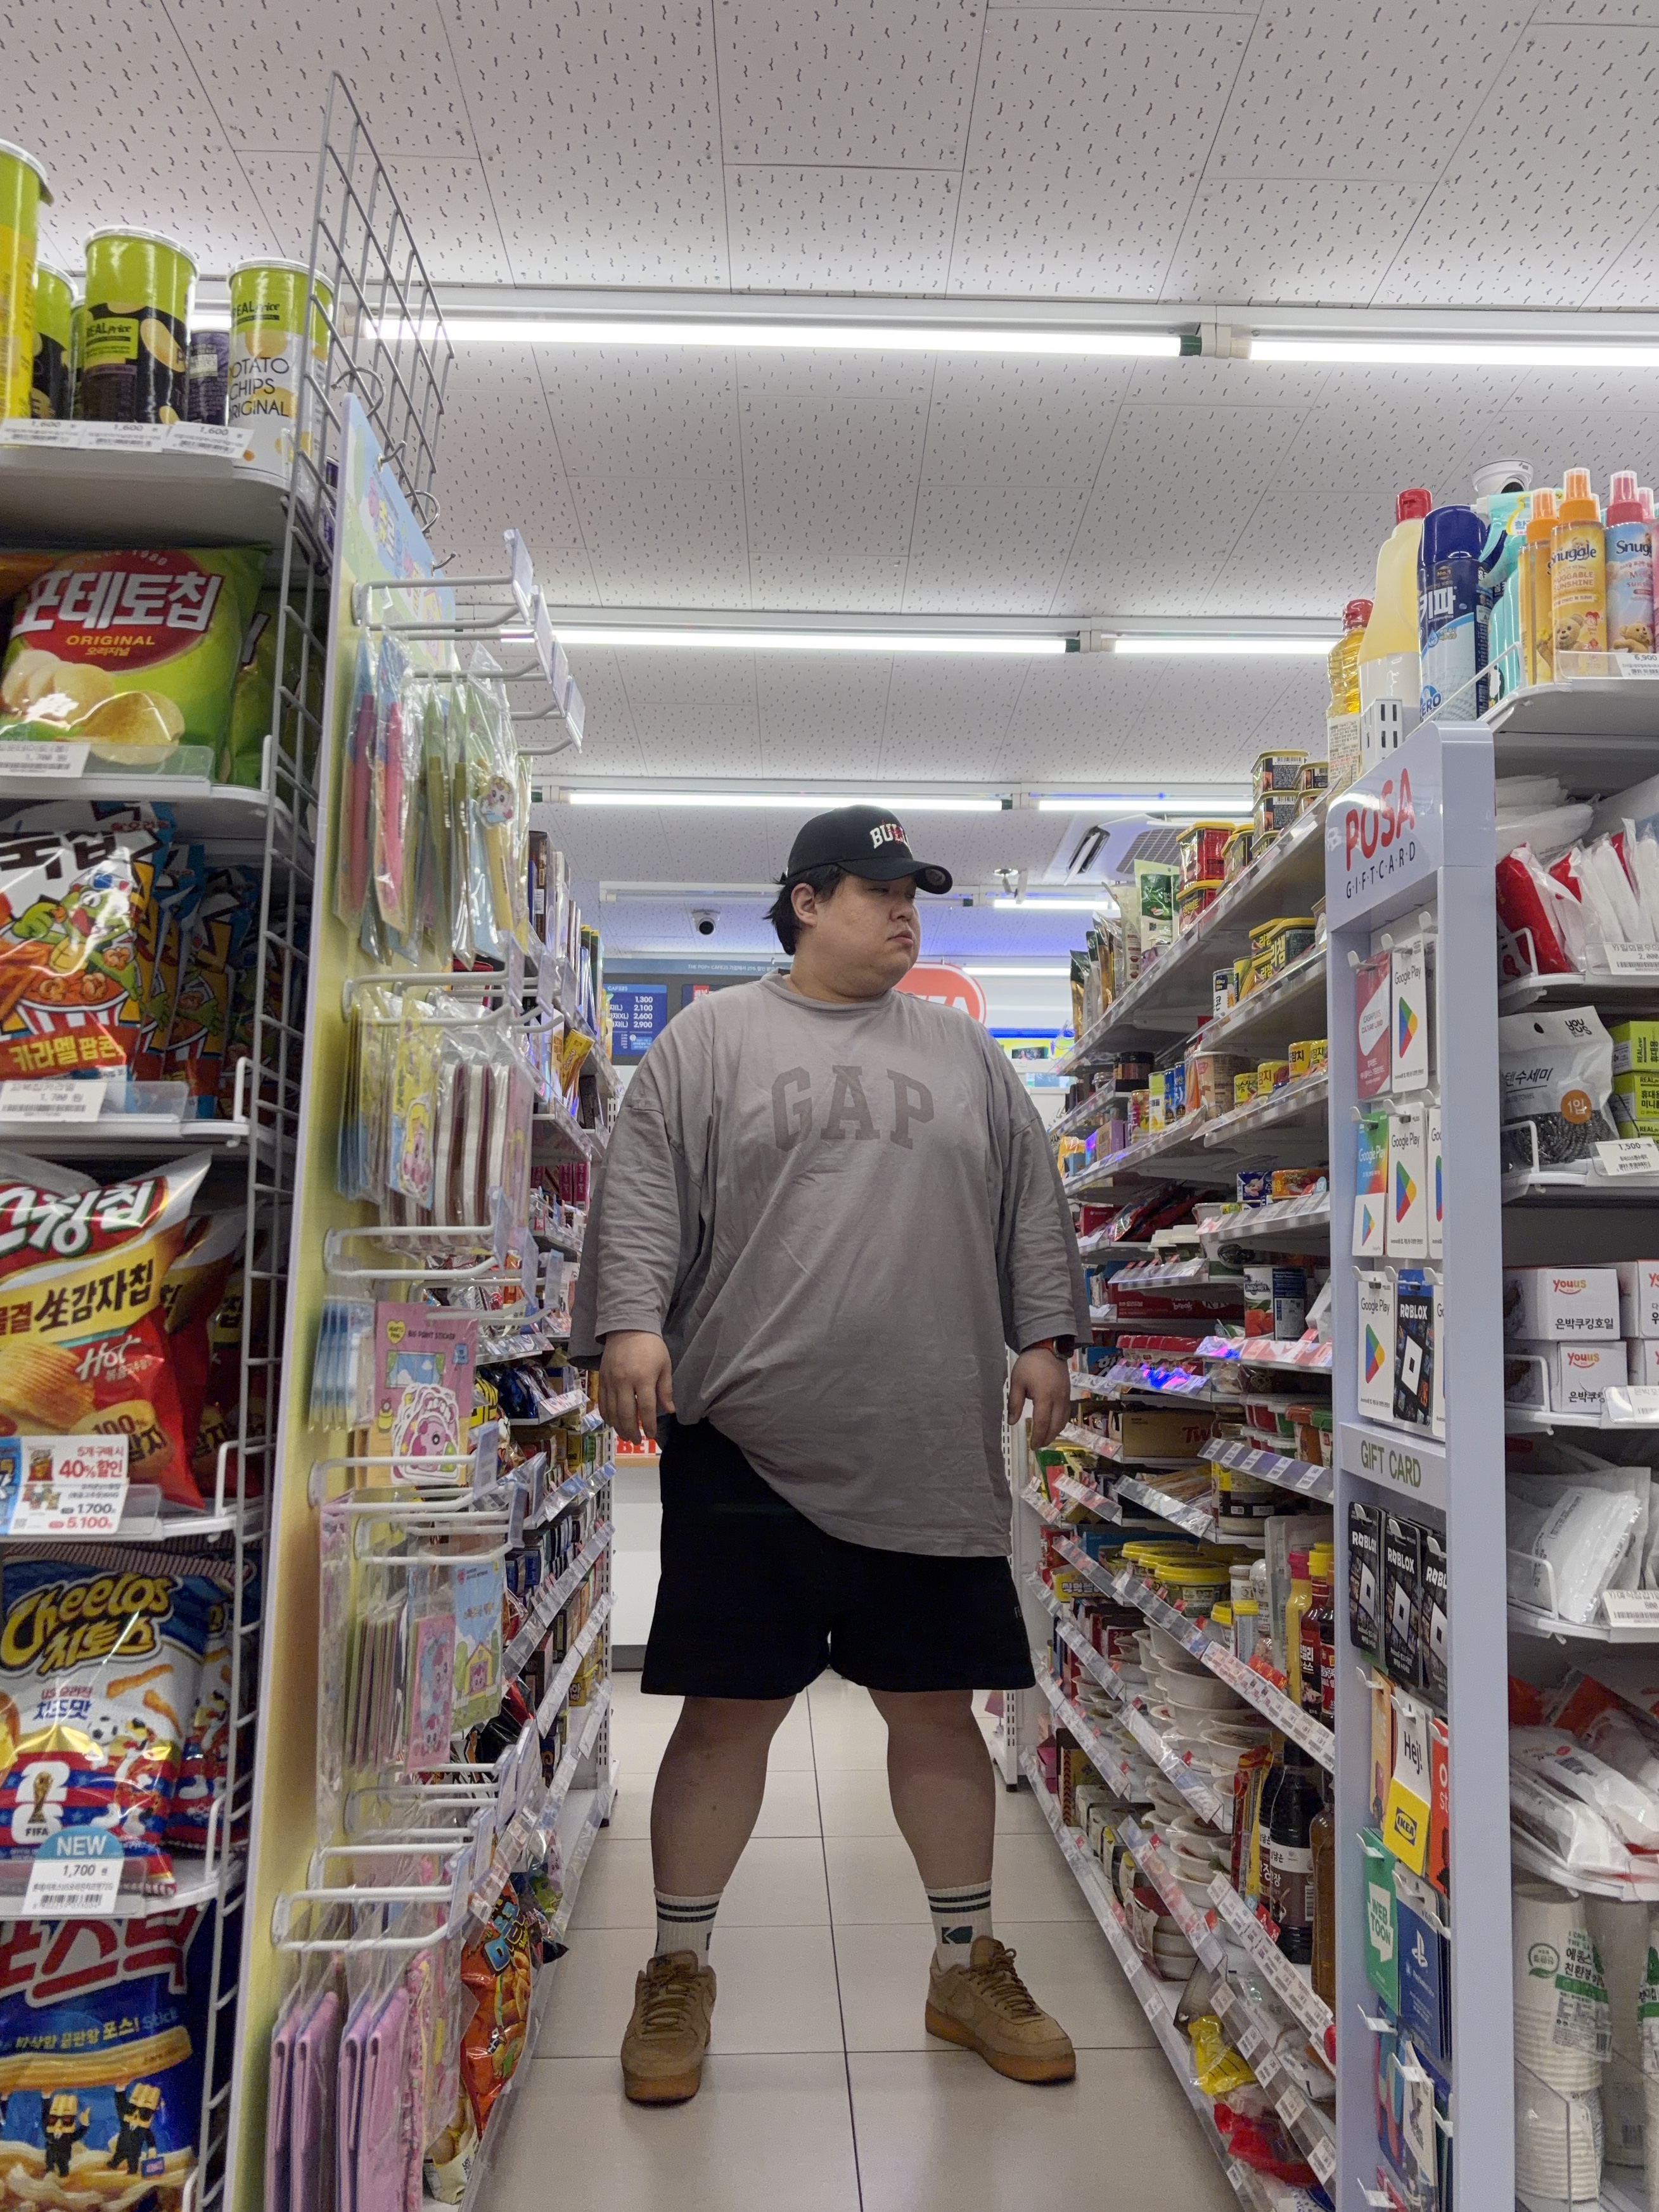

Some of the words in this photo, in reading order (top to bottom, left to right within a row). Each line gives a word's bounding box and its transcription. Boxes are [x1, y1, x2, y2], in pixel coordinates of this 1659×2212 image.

[229, 378, 276, 401] CHIPS
[113, 423, 143, 432] 1,600
[200, 426, 229, 436] 1,600
[66, 636, 156, 645] ORIGINAL
[1394, 968, 1411, 985] Google
[1411, 965, 1421, 981] Play
[9, 1038, 77, 1071] 카라멜
[771, 1065, 935, 1152] GAP
[1392, 1134, 1409, 1149] Google
[1409, 1132, 1420, 1148] Play
[1618, 1142, 1641, 1151] 1,500
[1359, 1147, 1376, 1164] Google
[1553, 1279, 1587, 1293] youus
[1173, 1301, 1193, 1312] break
[1361, 1297, 1378, 1314] Google
[1379, 1300, 1390, 1314] Play
[1400, 1303, 1428, 1320] ROBLOX
[1555, 1318, 1613, 1330] 은박쿠킹호일
[75, 1334, 141, 1381] Hot
[1567, 1352, 1600, 1366] youus
[60, 1459, 96, 1478] 40%
[97, 1459, 123, 1478] 할인
[1361, 1440, 1385, 1474] GIFT
[1389, 1449, 1421, 1488] CARD
[1387, 1547, 1415, 1575] ROBLOX
[0, 1574, 172, 1669] Cheetos
[37, 1617, 155, 1677] 치토스
[33, 1699, 92, 1721] 치즈맛
[1404, 1730, 1423, 1775] Hej!
[25, 1828, 49, 1836] FIFA
[1397, 1817, 1414, 1838] IKEA
[57, 1835, 107, 1857] NEW
[63, 1864, 96, 1878] 1,700
[1371, 1898, 1388, 1927] WEB
[1371, 1911, 1391, 1946] TOON
